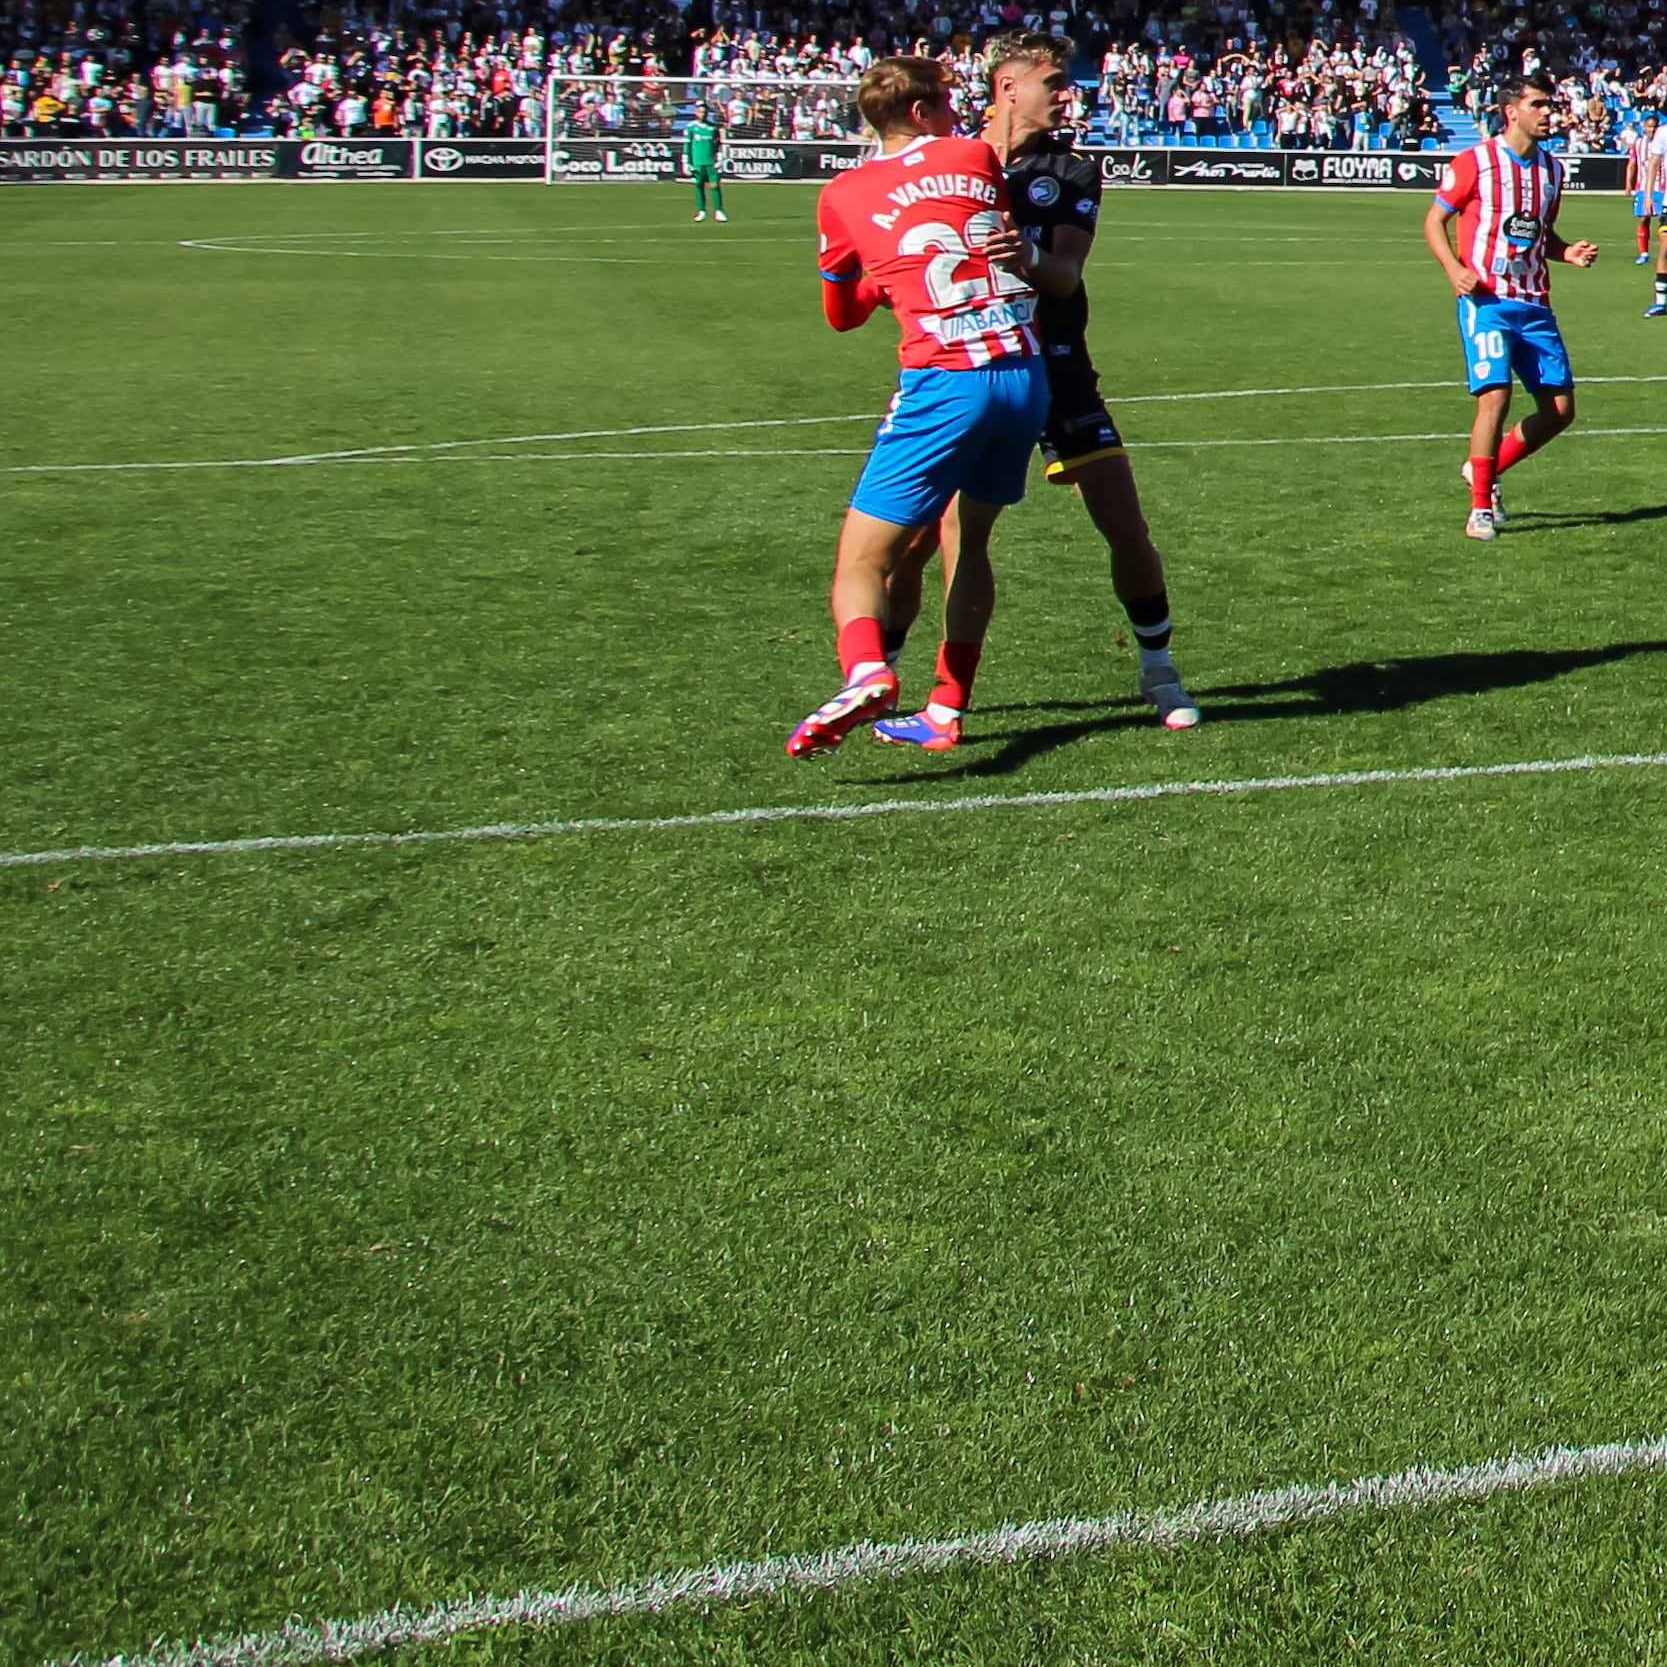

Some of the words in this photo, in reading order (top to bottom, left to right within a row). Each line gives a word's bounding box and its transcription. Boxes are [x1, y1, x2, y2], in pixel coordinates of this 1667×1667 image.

[98, 149, 130, 168] DE
[135, 149, 180, 168] LOS
[184, 149, 276, 168] FRAILES
[506, 154, 545, 165] MOTOR
[552, 150, 602, 173] Coco
[606, 150, 676, 173] Lastra
[1322, 157, 1393, 180] FLOYMA
[872, 208, 900, 231] A.
[1474, 331, 1504, 361] 10
